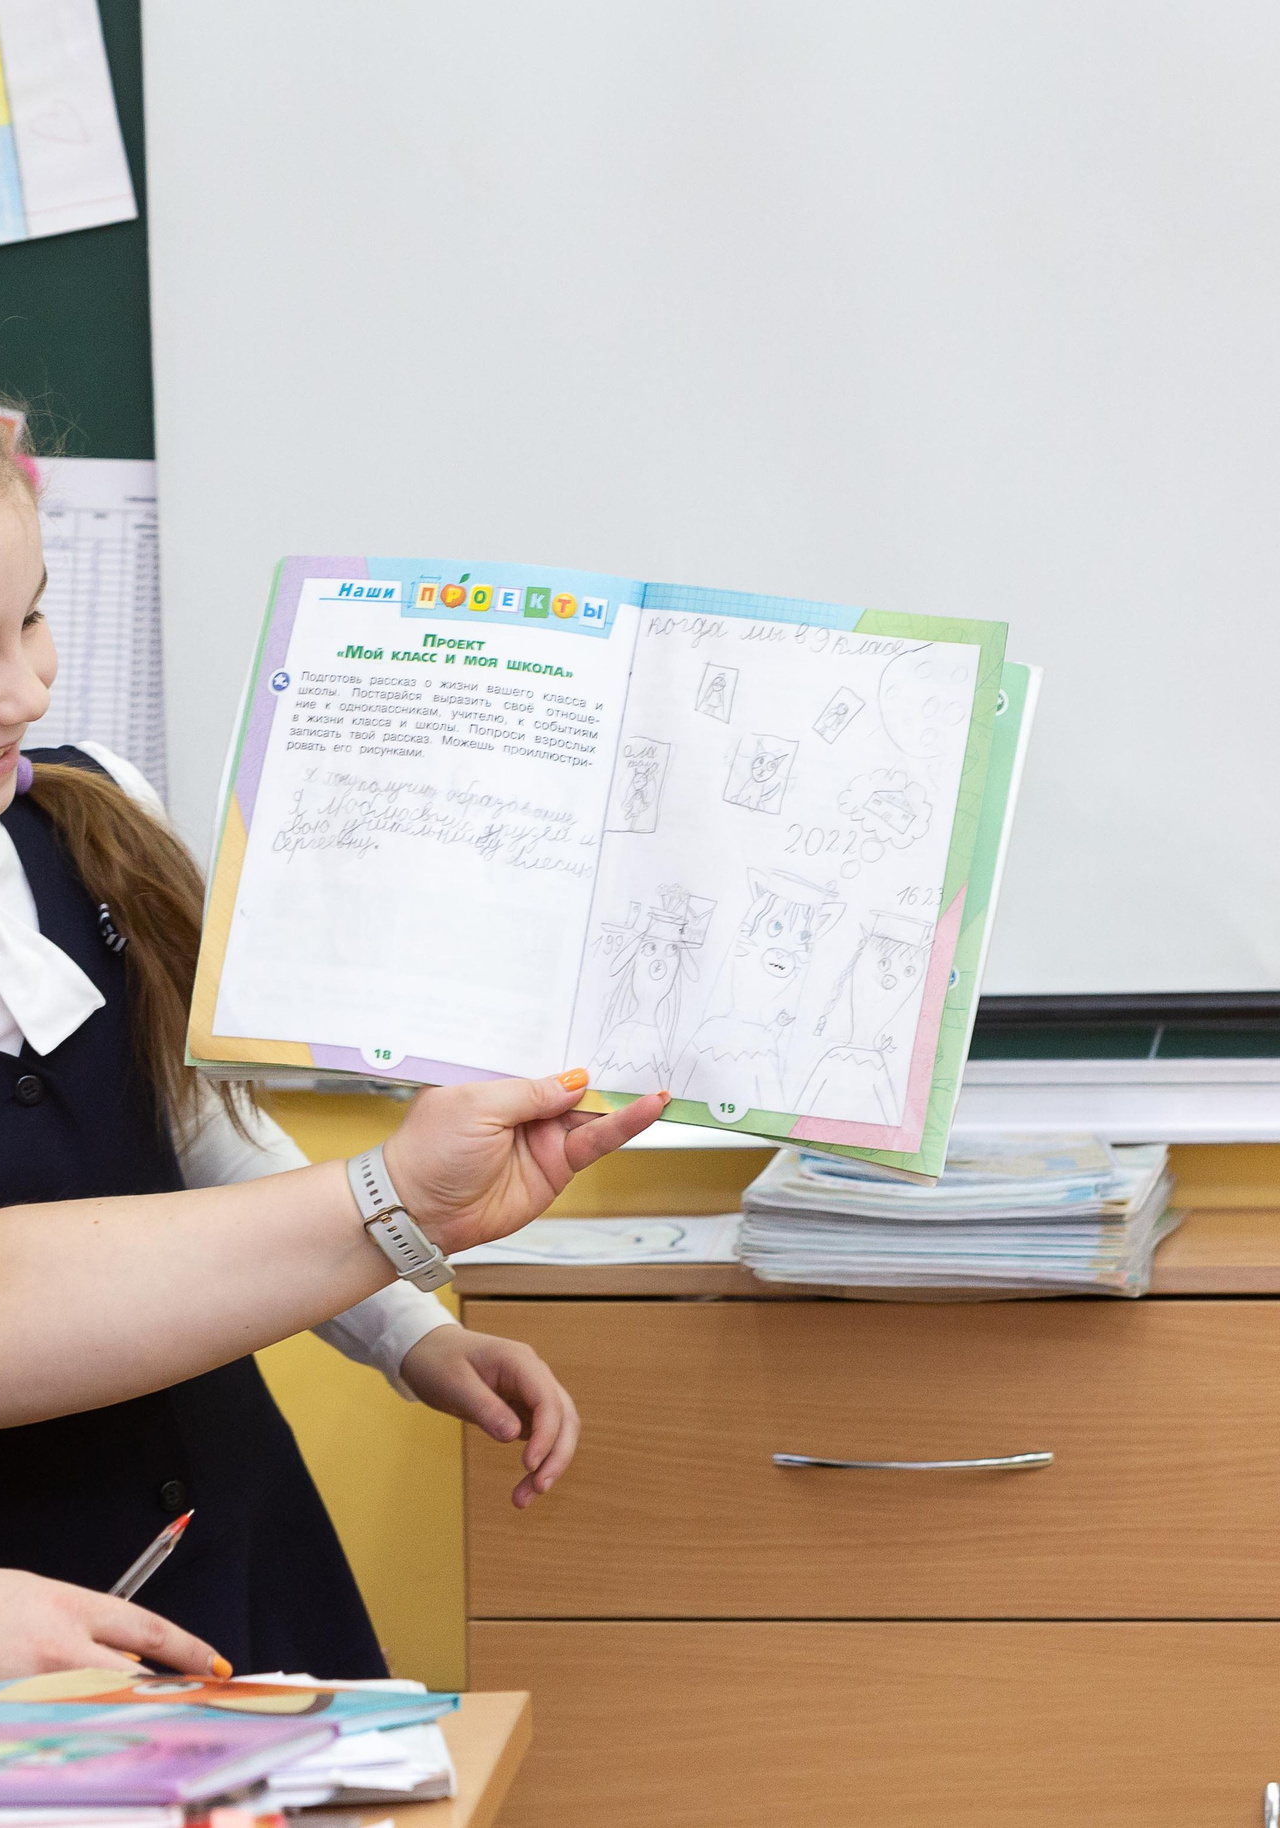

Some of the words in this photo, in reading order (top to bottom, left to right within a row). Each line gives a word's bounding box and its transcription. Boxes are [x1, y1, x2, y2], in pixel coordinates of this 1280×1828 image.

[337, 581, 396, 600] Наши
[417, 585, 606, 622] ПРОЕКТЫ
[297, 686, 341, 697] школы.
[351, 687, 422, 702] Постарайся
[433, 694, 492, 709] выразить
[503, 699, 535, 713] своё
[546, 706, 601, 725] отноше-
[300, 671, 363, 685] Подготовь
[369, 676, 417, 688] рассказ
[424, 679, 433, 688] о
[439, 680, 479, 692] жизни
[487, 684, 534, 699] вашего
[543, 692, 587, 708] класса
[595, 702, 604, 712] и
[292, 713, 300, 722] в
[306, 715, 345, 725] жизни
[351, 717, 392, 728] класса
[399, 720, 407, 728] и
[415, 720, 459, 733] школы.
[469, 723, 526, 741] Попроси
[534, 734, 597, 755] взрослых
[295, 700, 317, 709] ние
[324, 702, 332, 710] к
[339, 702, 442, 718] одноклассникам,
[451, 709, 507, 726] учителю,
[518, 718, 525, 726] к
[533, 718, 599, 740] событиям
[286, 740, 326, 753] ровать
[333, 743, 353, 755] его
[359, 744, 425, 759] рисунками.
[289, 726, 342, 740] записать
[349, 729, 376, 741] твой
[382, 732, 433, 745] рассказ.
[441, 735, 495, 752] Можешь
[503, 744, 593, 768] проиллюстри-
[783, 823, 858, 857] 2022
[374, 1048, 392, 1060] 18
[719, 1102, 736, 1114] 19
